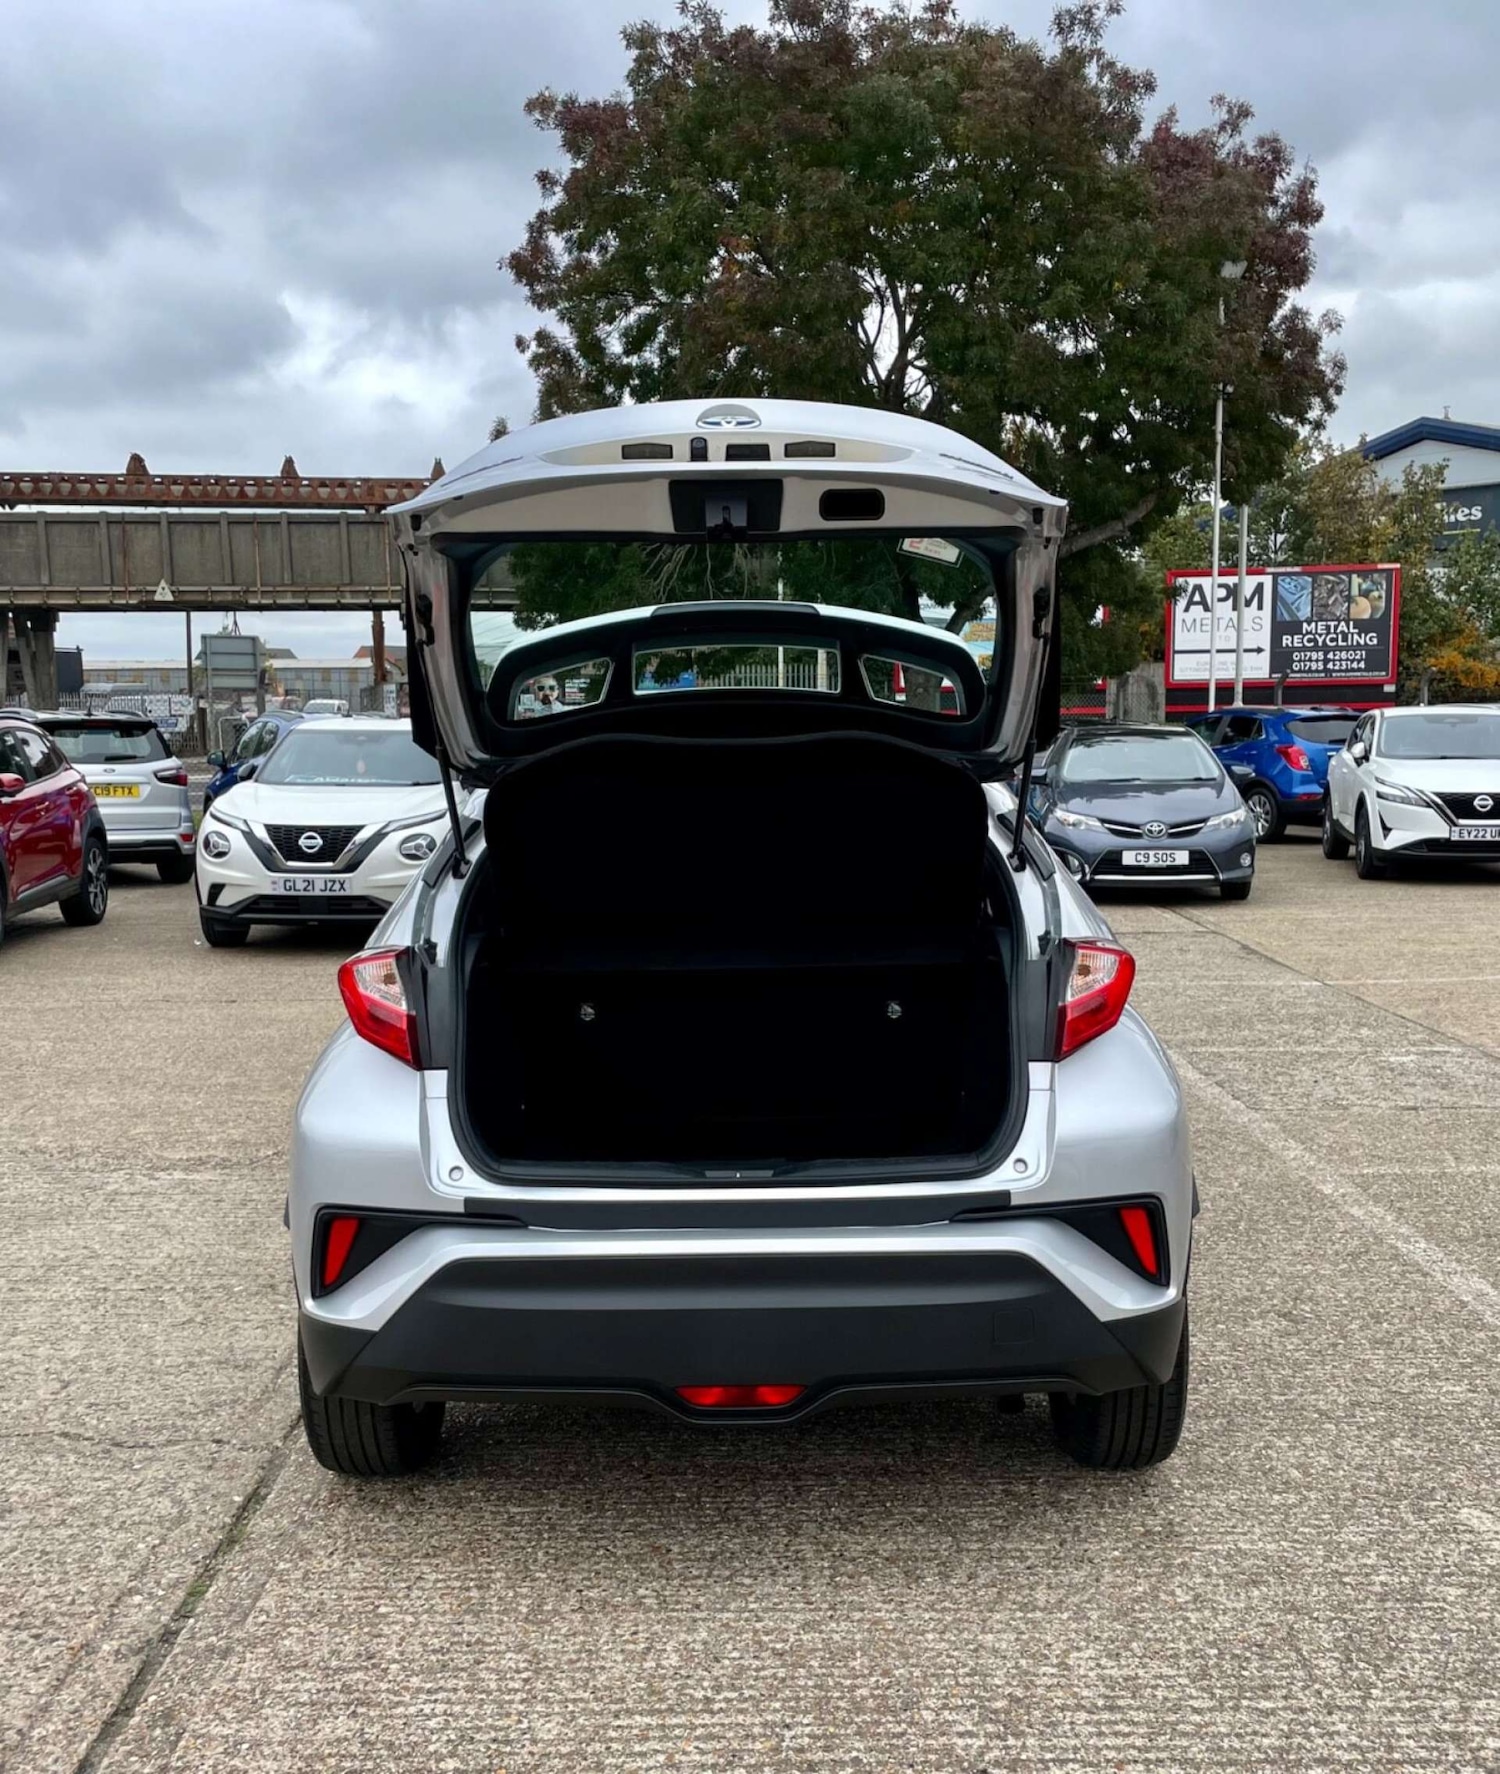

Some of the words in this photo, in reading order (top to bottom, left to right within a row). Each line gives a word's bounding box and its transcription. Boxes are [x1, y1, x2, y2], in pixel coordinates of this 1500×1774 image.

[1183, 582, 1264, 613] APM
[1302, 621, 1359, 634] METAL
[1282, 633, 1378, 647] RECYCLING
[1292, 651, 1324, 661] 01795
[1327, 650, 1366, 660] 426021
[1292, 661, 1324, 671] 01795
[1326, 661, 1365, 669] 423144
[113, 786, 133, 796] FTX
[1459, 829, 1487, 838] EY22
[1135, 852, 1150, 863] C9
[283, 879, 315, 892] GL21
[319, 879, 346, 892] JZX
